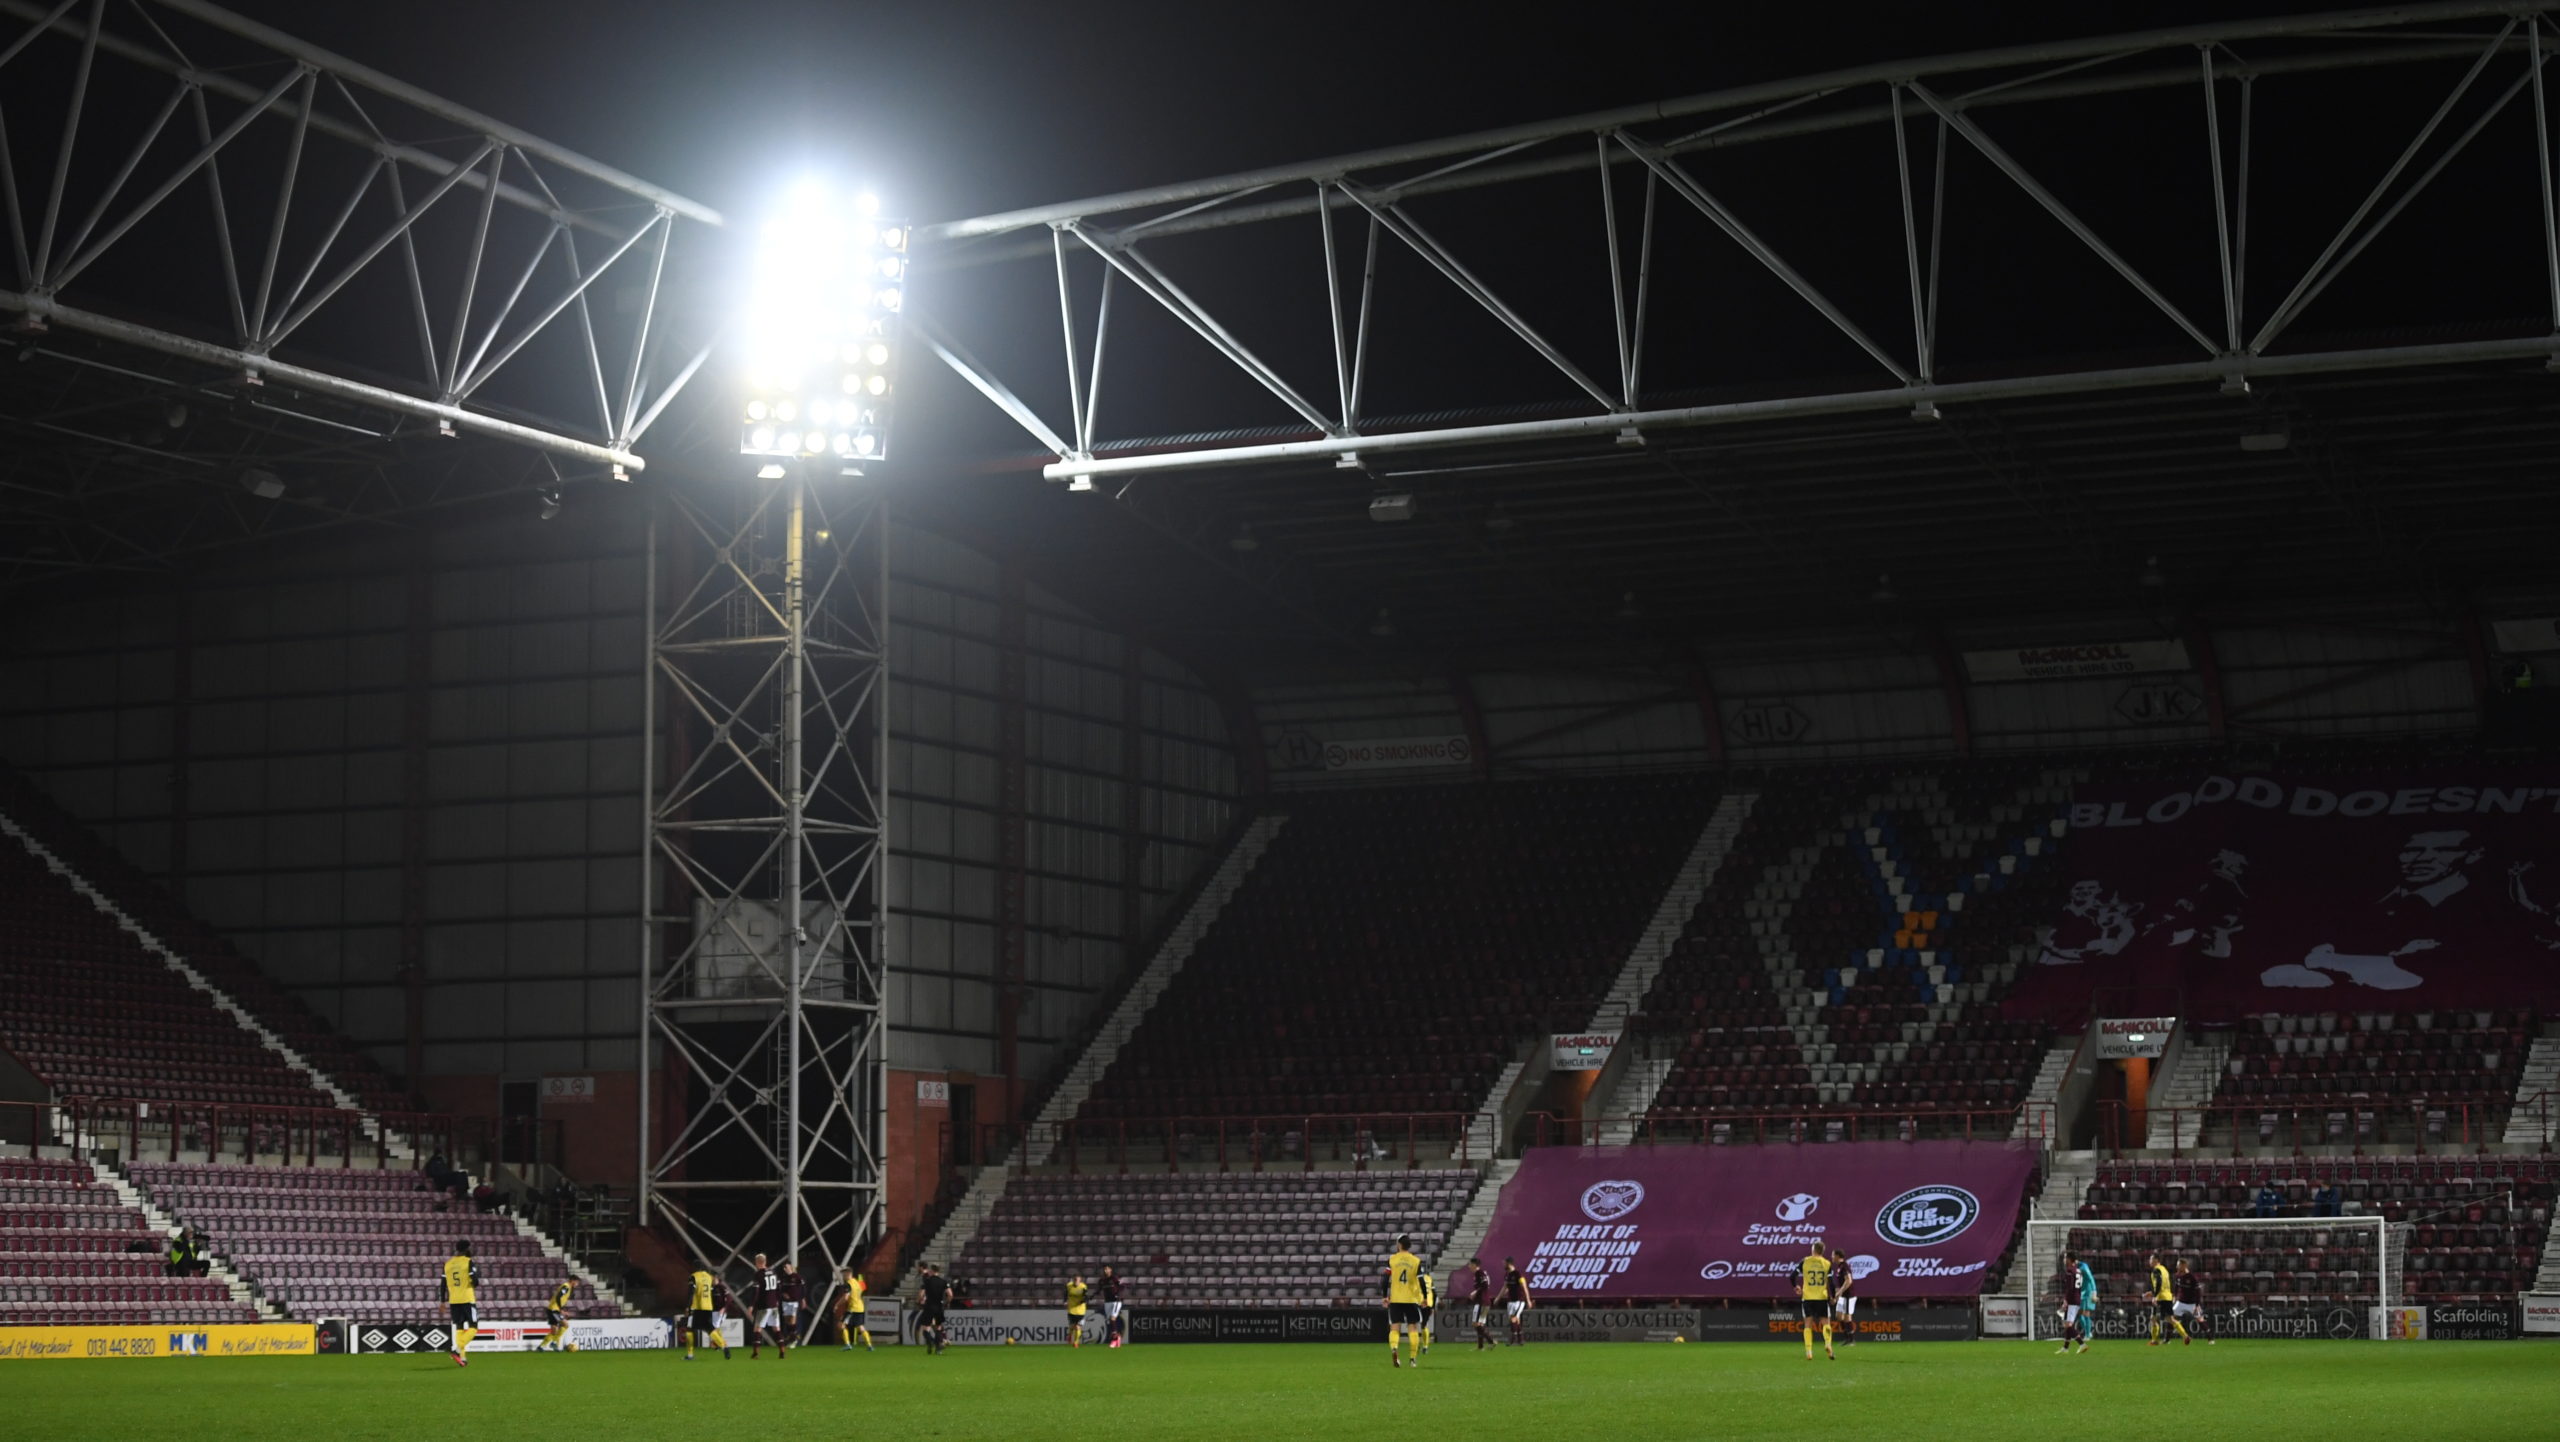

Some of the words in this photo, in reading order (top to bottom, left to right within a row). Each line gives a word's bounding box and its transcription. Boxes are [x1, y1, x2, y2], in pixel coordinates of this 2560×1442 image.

[2018, 646, 2130, 665] McNICOLL
[2024, 666, 2075, 677] VEHICLE
[2080, 664, 2107, 674] HIRE
[2112, 661, 2134, 672] LTD
[1350, 748, 1371, 762] NO
[1375, 743, 1446, 761] SMOKING
[2070, 775, 2283, 828] BLOOD
[2102, 1021, 2170, 1035] McNICOLL
[1555, 1036, 1616, 1049] McNICOLL
[2102, 1045, 2133, 1054] VEHICLE
[1556, 1058, 1585, 1067] VEHICLE
[1748, 1223, 1792, 1233] Save
[1795, 1222, 1826, 1233] the
[1900, 1215, 1955, 1230] Hearts
[1555, 1225, 1613, 1239] HEART
[1613, 1225, 1638, 1239] OF
[1742, 1234, 1822, 1246] Children
[1534, 1241, 1642, 1256] MIDLOTHIAN
[1525, 1258, 1545, 1273] IS
[1546, 1257, 1606, 1273] PROUD
[1607, 1257, 1631, 1273] TO
[1736, 1260, 1766, 1273] tiny
[1769, 1260, 1799, 1272] tick
[1892, 1260, 1987, 1277] CHANGES
[1898, 1257, 1943, 1268] TINY
[452, 1271, 460, 1287] 5
[764, 1275, 777, 1291] 10
[1399, 1269, 1407, 1283] 4
[1528, 1274, 1611, 1290] SUPPORT
[1807, 1270, 1825, 1286] 33
[943, 1316, 993, 1326] SCOTTISH
[1132, 1316, 1169, 1329] KEITH
[1172, 1316, 1212, 1330] GUNN
[1289, 1317, 1327, 1330] KEITH
[1330, 1317, 1372, 1330] GUNN
[1442, 1312, 1530, 1328] CHRLE
[1537, 1312, 1597, 1328] IRONS
[1602, 1312, 1696, 1328] COACHES
[2433, 1309, 2508, 1326] Scaffolding
[571, 1327, 602, 1336] SCOTTISH
[1859, 1321, 1902, 1333] SIGNS
[2215, 1314, 2318, 1337] Edinburgh
[495, 1328, 522, 1341] SIDEY
[1523, 1331, 1549, 1342] 0131
[1554, 1331, 1574, 1342] 441
[1578, 1331, 1610, 1342] 2222
[2433, 1329, 2456, 1340] 0131
[2461, 1329, 2480, 1340] 664
[2484, 1328, 2508, 1340] 4125
[87, 1338, 107, 1355] 0131
[109, 1338, 128, 1355] 442
[130, 1338, 155, 1355] 8820
[169, 1333, 208, 1355] MKM
[572, 1336, 650, 1351] CHAMPIONSHIP
